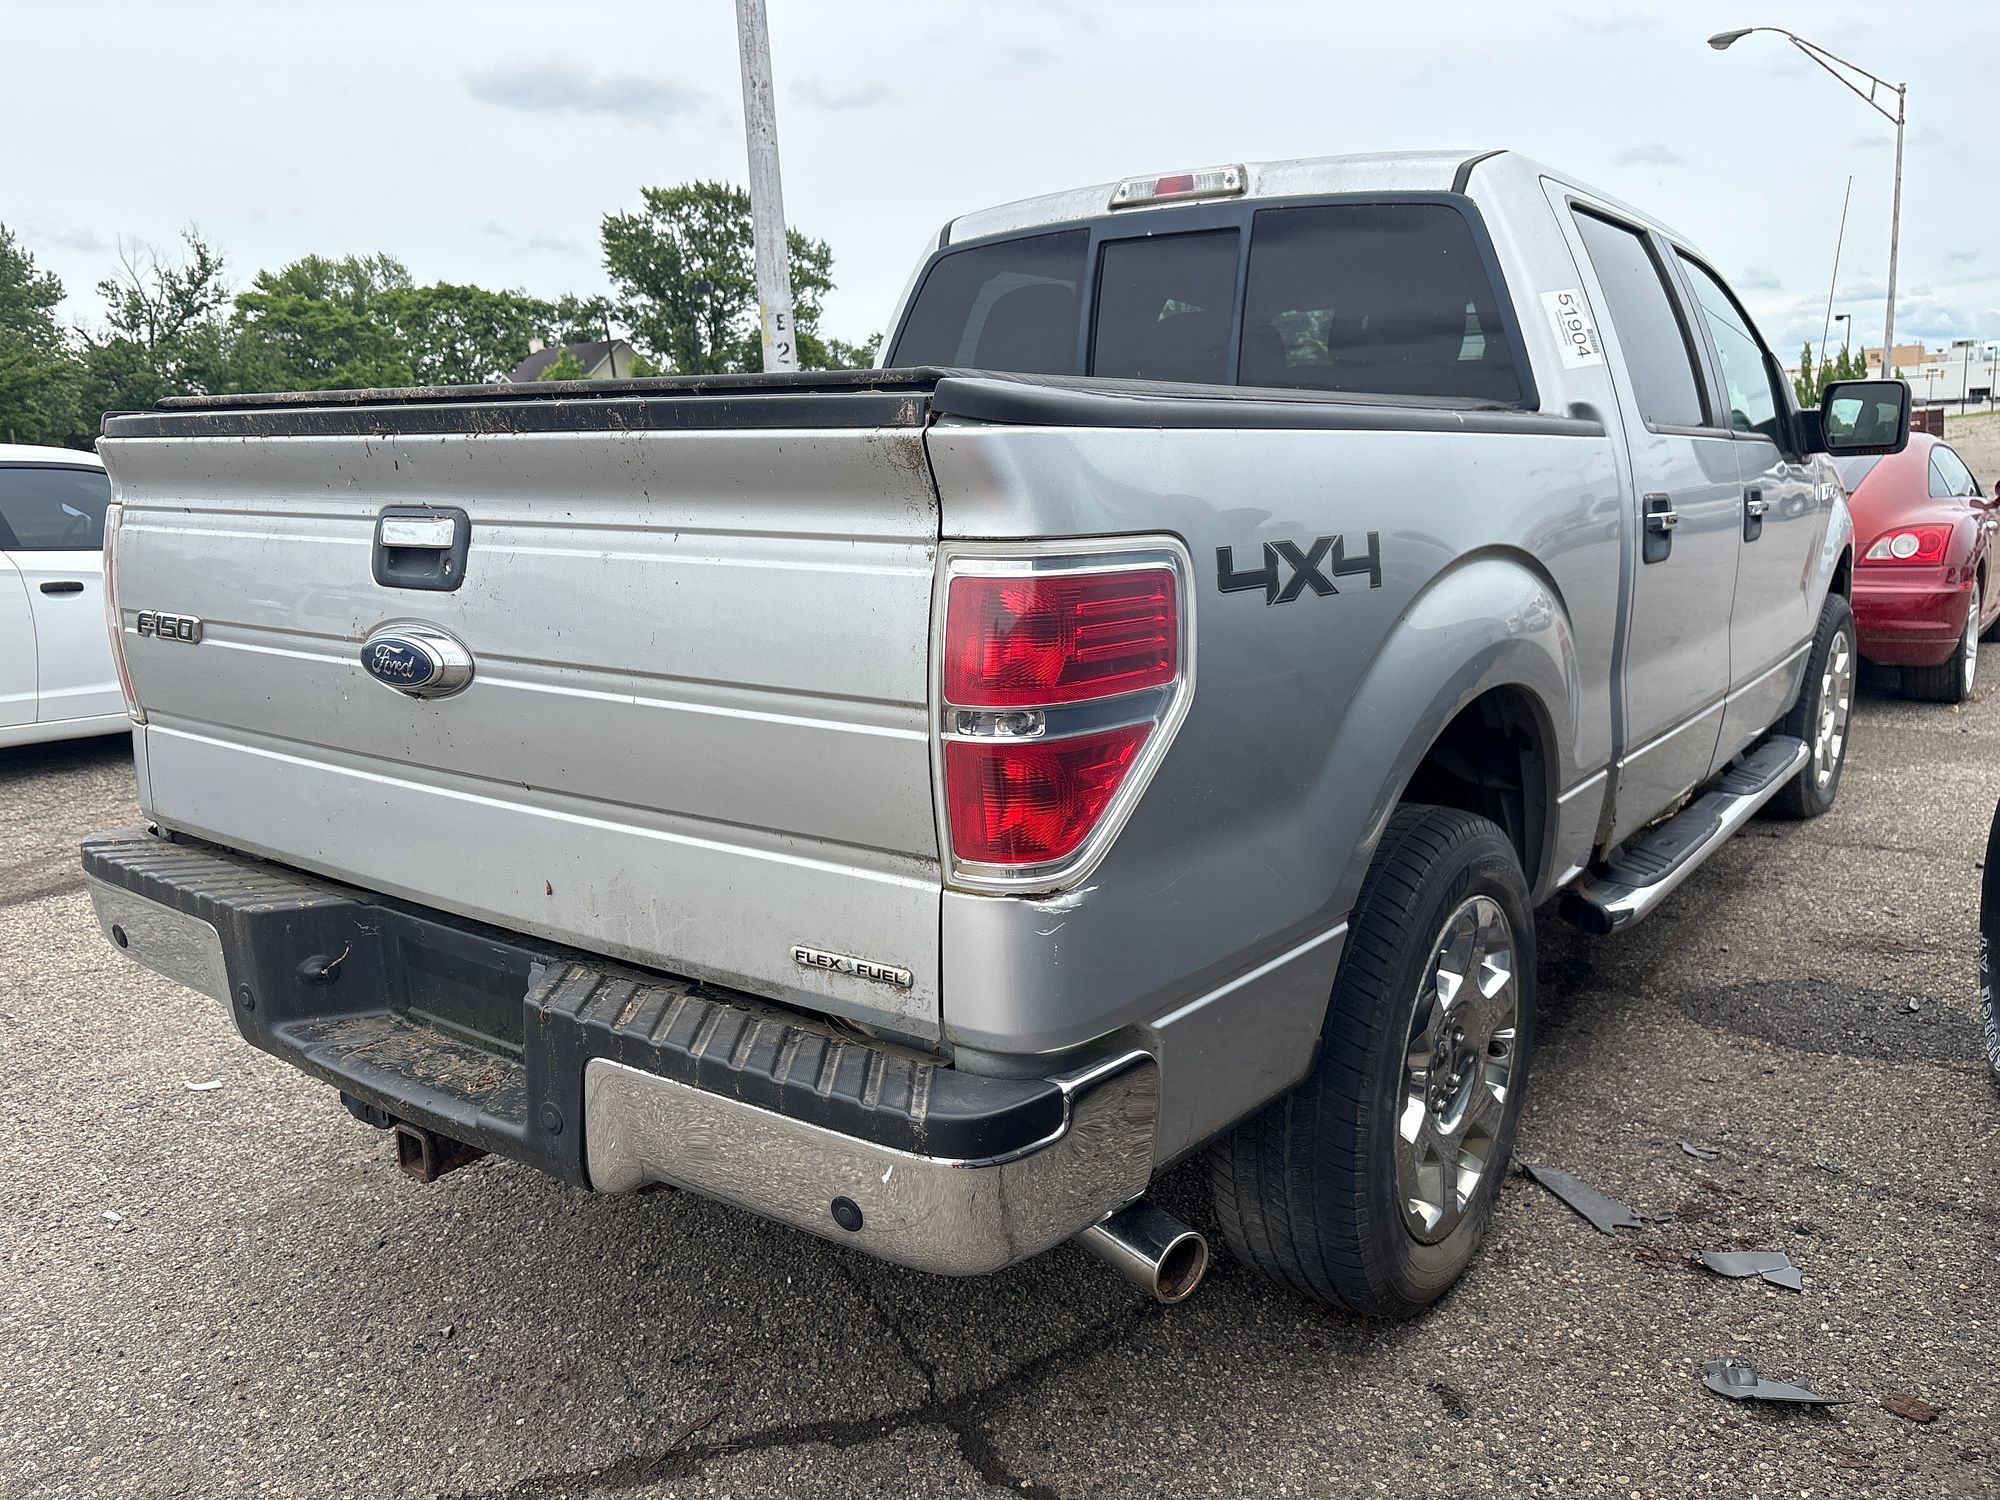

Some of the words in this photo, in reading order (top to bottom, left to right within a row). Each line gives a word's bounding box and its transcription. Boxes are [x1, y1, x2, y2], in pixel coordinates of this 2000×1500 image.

[1558, 293, 1592, 359] 51904
[776, 341, 791, 365] 2
[138, 609, 203, 645] F-150
[372, 643, 416, 678] Ford
[794, 949, 842, 971] FLEX
[856, 963, 906, 986] FUEL
